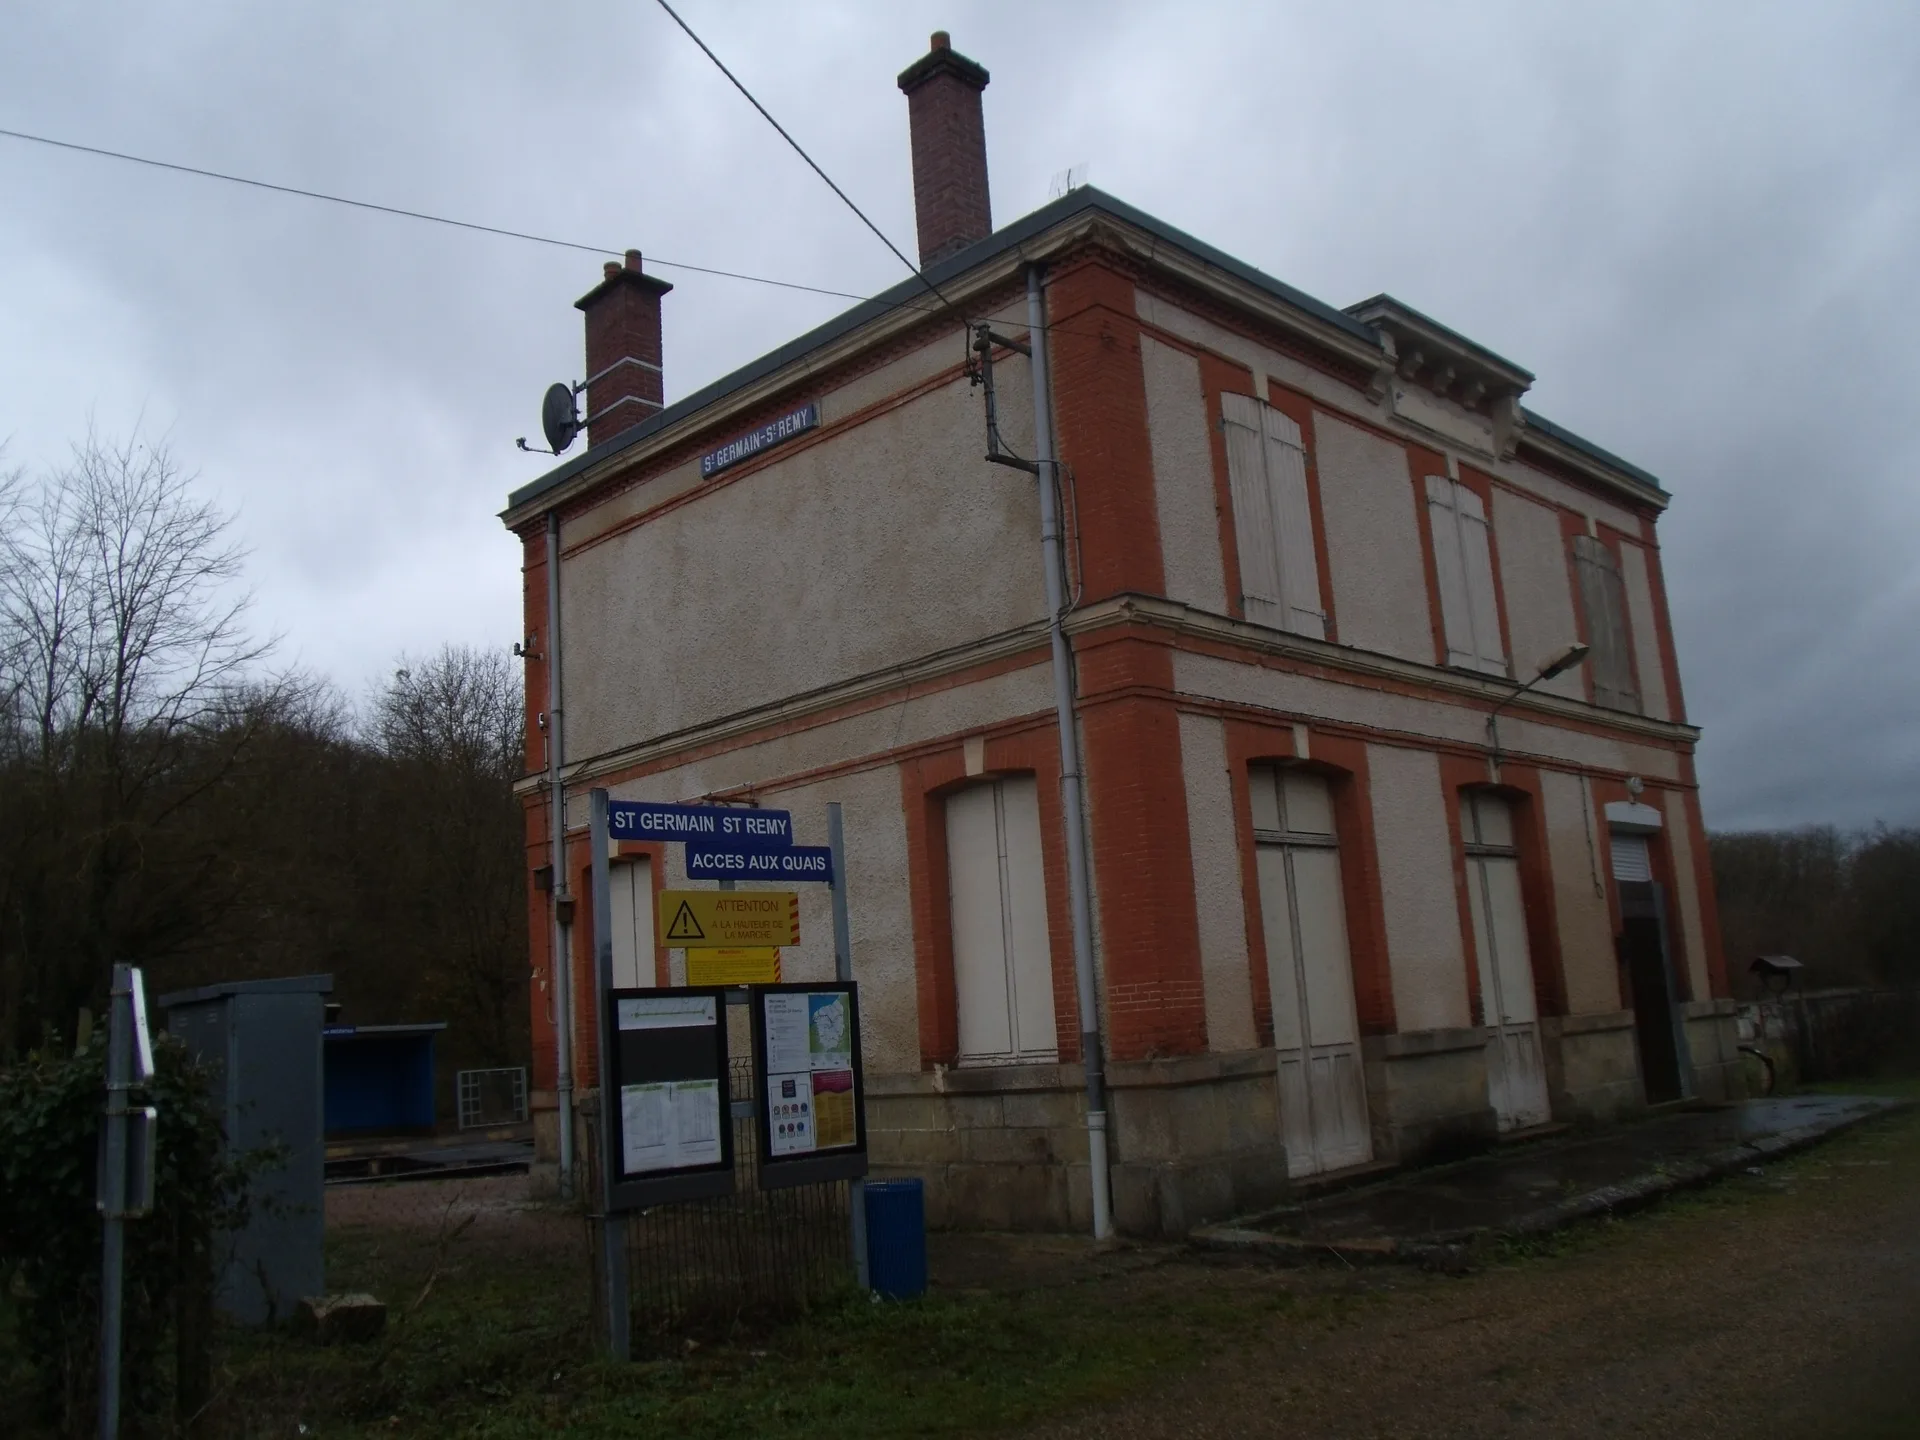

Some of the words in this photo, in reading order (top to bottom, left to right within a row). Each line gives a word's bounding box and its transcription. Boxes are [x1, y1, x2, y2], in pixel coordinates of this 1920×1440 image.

[615, 812, 635, 829] ST
[640, 812, 714, 832] GERMAIN
[723, 817, 741, 833] ST
[746, 818, 786, 836] REMY
[692, 854, 744, 869] ACCES
[749, 855, 778, 870] AUX
[782, 856, 826, 871] QUAIS
[715, 900, 779, 912] ATTENTION
[720, 921, 731, 929] LA
[733, 921, 770, 929] HAUTEUR
[724, 931, 736, 940] LA
[737, 931, 772, 940] MARCHE
